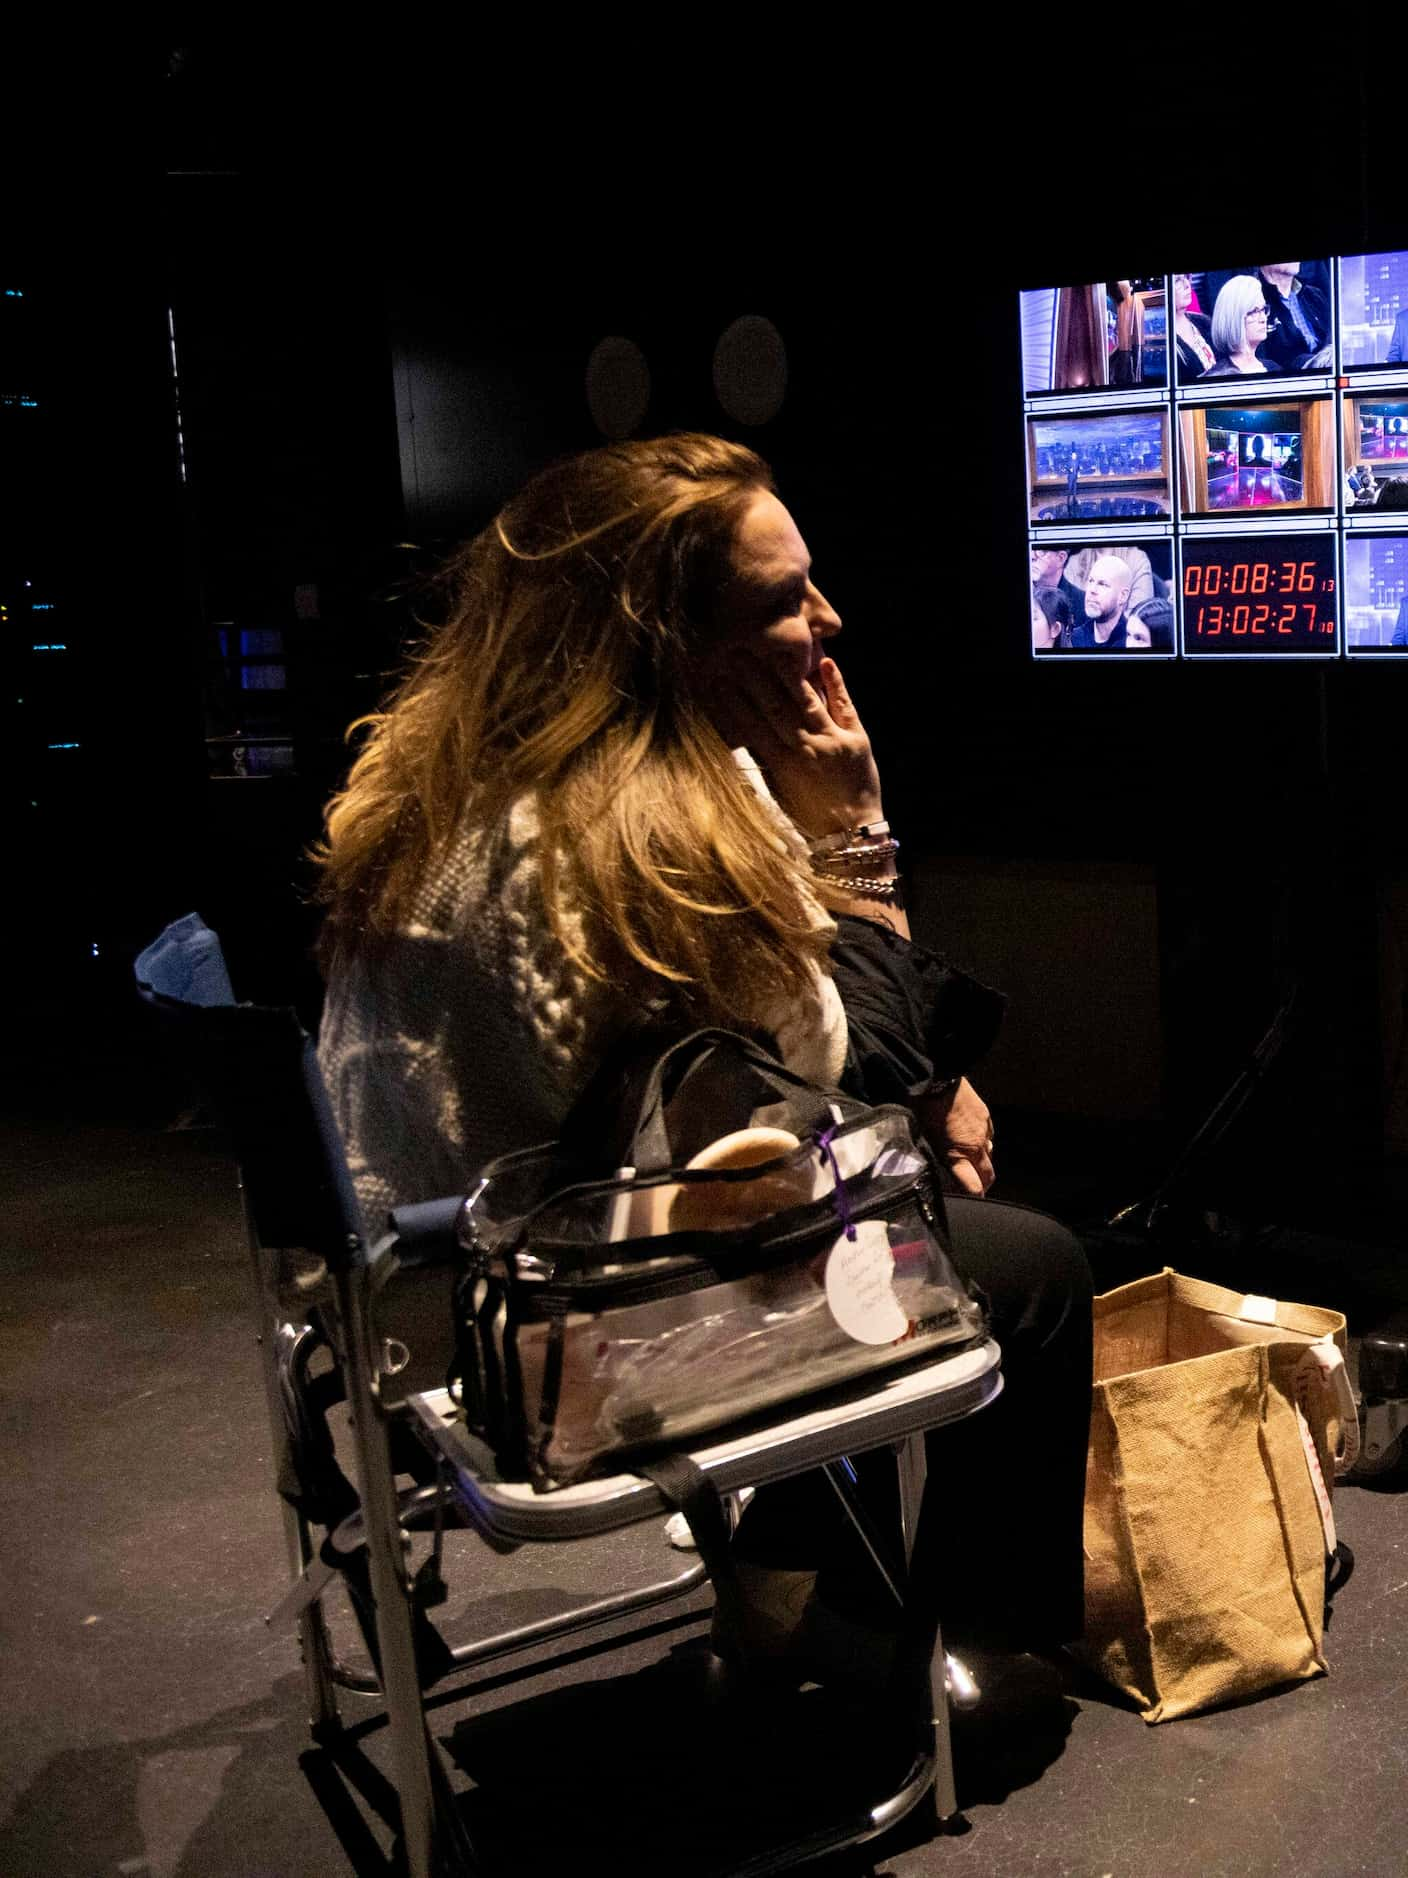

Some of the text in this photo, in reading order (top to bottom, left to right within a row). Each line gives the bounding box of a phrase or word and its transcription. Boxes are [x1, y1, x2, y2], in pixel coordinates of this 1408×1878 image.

[1184, 562, 1335, 596] 00:08:36 13
[1197, 605, 1317, 635] 13:02:27
